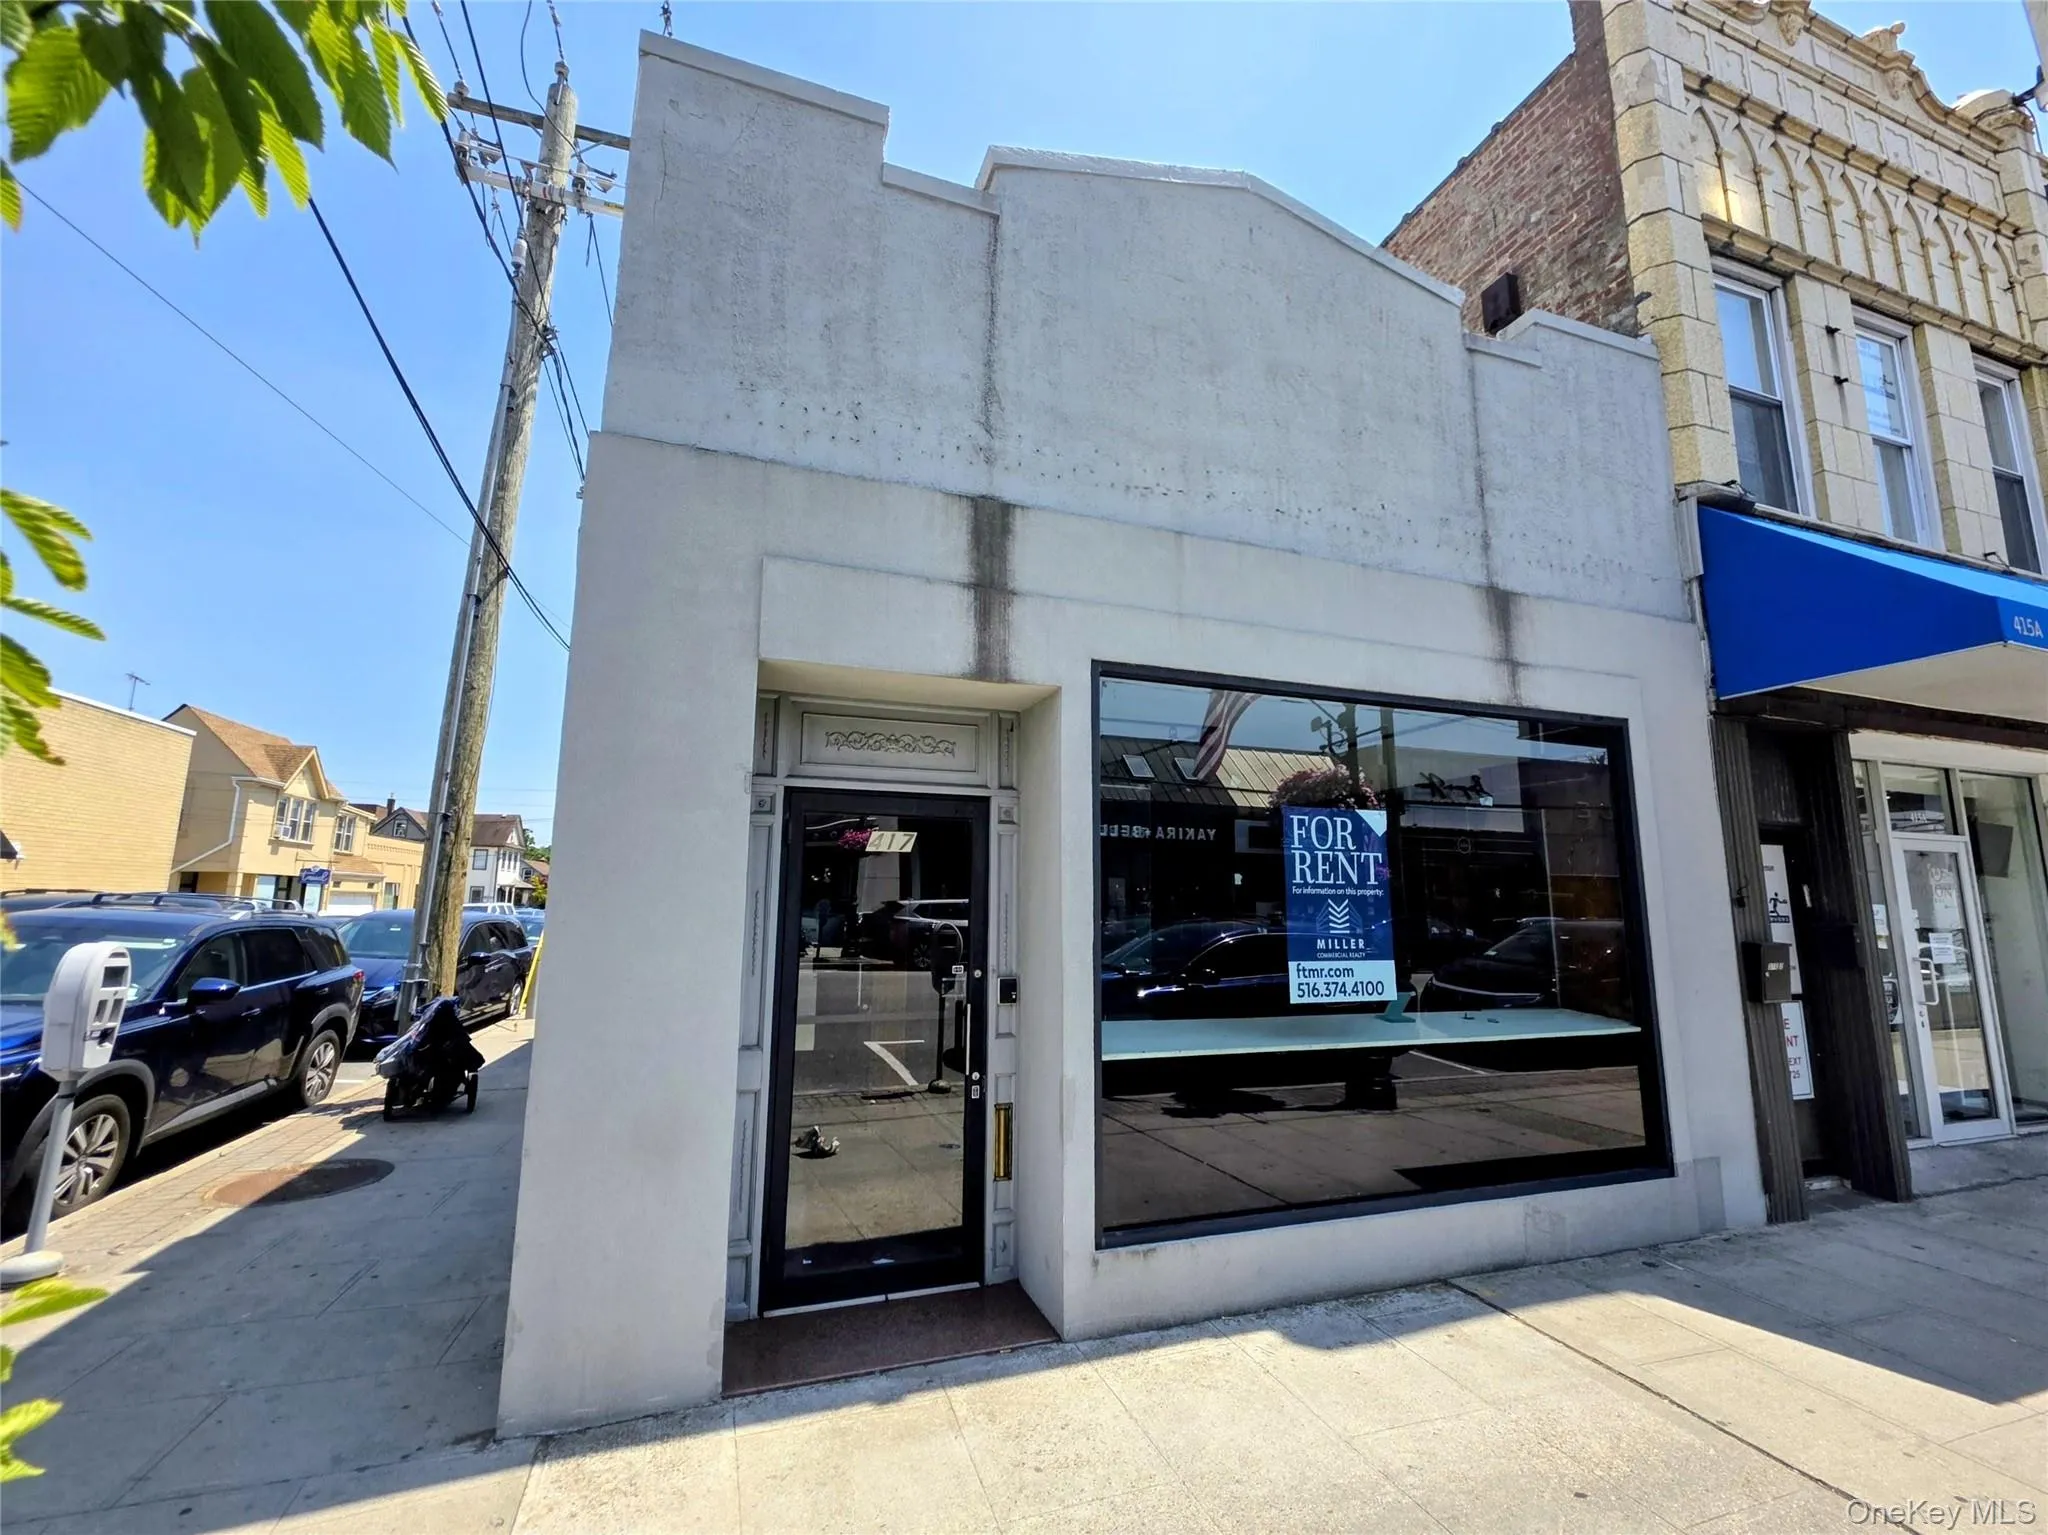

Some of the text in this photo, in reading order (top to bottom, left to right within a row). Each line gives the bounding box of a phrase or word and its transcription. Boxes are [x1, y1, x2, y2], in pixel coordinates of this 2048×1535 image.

[2013, 615, 2044, 639] 415A
[868, 832, 915, 851] 417
[1290, 815, 1356, 850] FOR
[1291, 850, 1382, 885] RENT
[1292, 886, 1302, 895] For
[1302, 886, 1336, 895] information
[1345, 886, 1356, 896] this
[1357, 888, 1384, 897] property:
[1316, 938, 1365, 950] MILLER
[1296, 963, 1354, 979] ftmr.com
[1297, 980, 1385, 998] 516.374.4100
